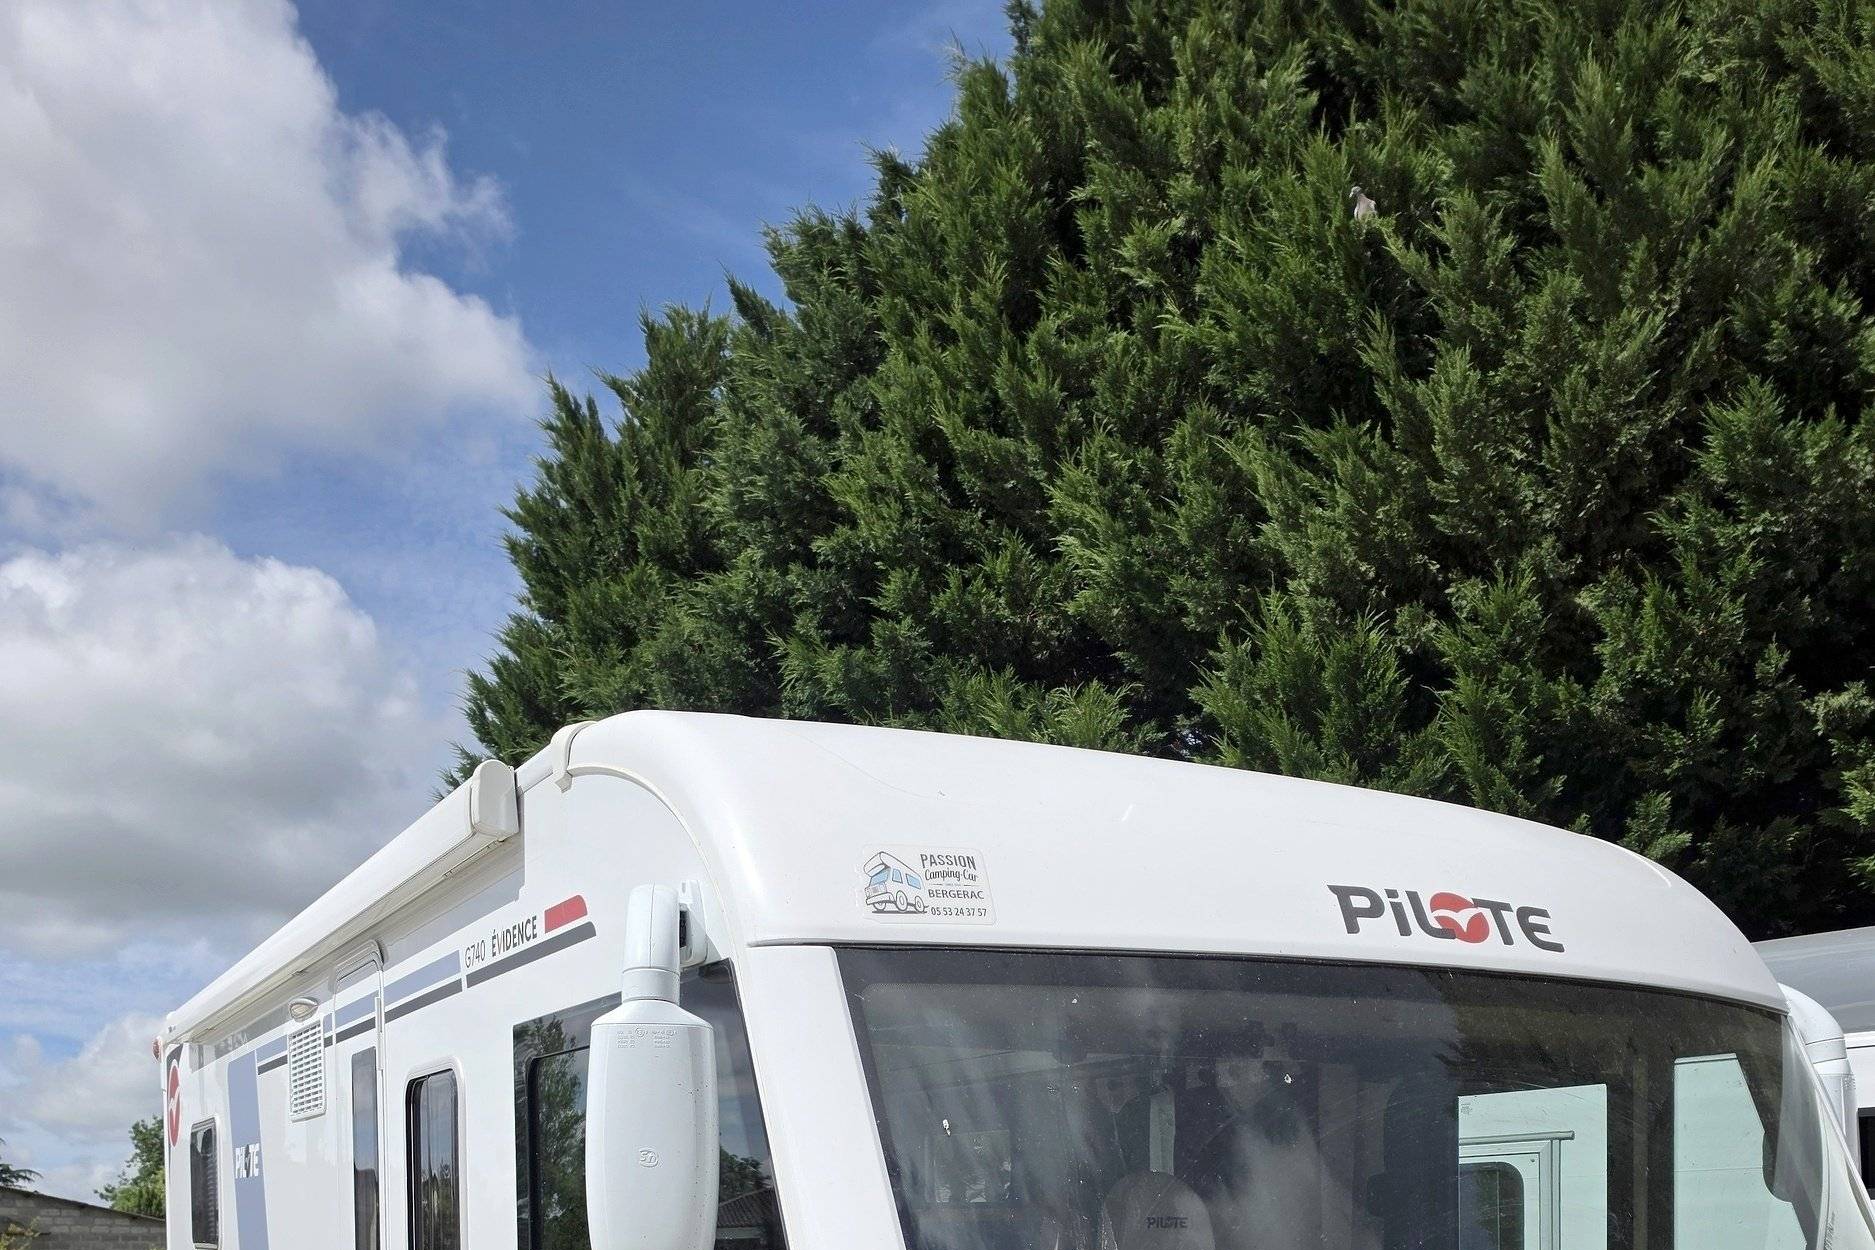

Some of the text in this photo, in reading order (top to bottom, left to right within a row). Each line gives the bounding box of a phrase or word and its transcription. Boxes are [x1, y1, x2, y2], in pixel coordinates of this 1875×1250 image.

[920, 853, 976, 871] PASSION
[925, 867, 978, 882] Camping-Car
[928, 889, 984, 900] BERGERAC
[931, 907, 987, 917] 05 53 24 37 57
[465, 914, 538, 969] G740 ÉVIDENCE
